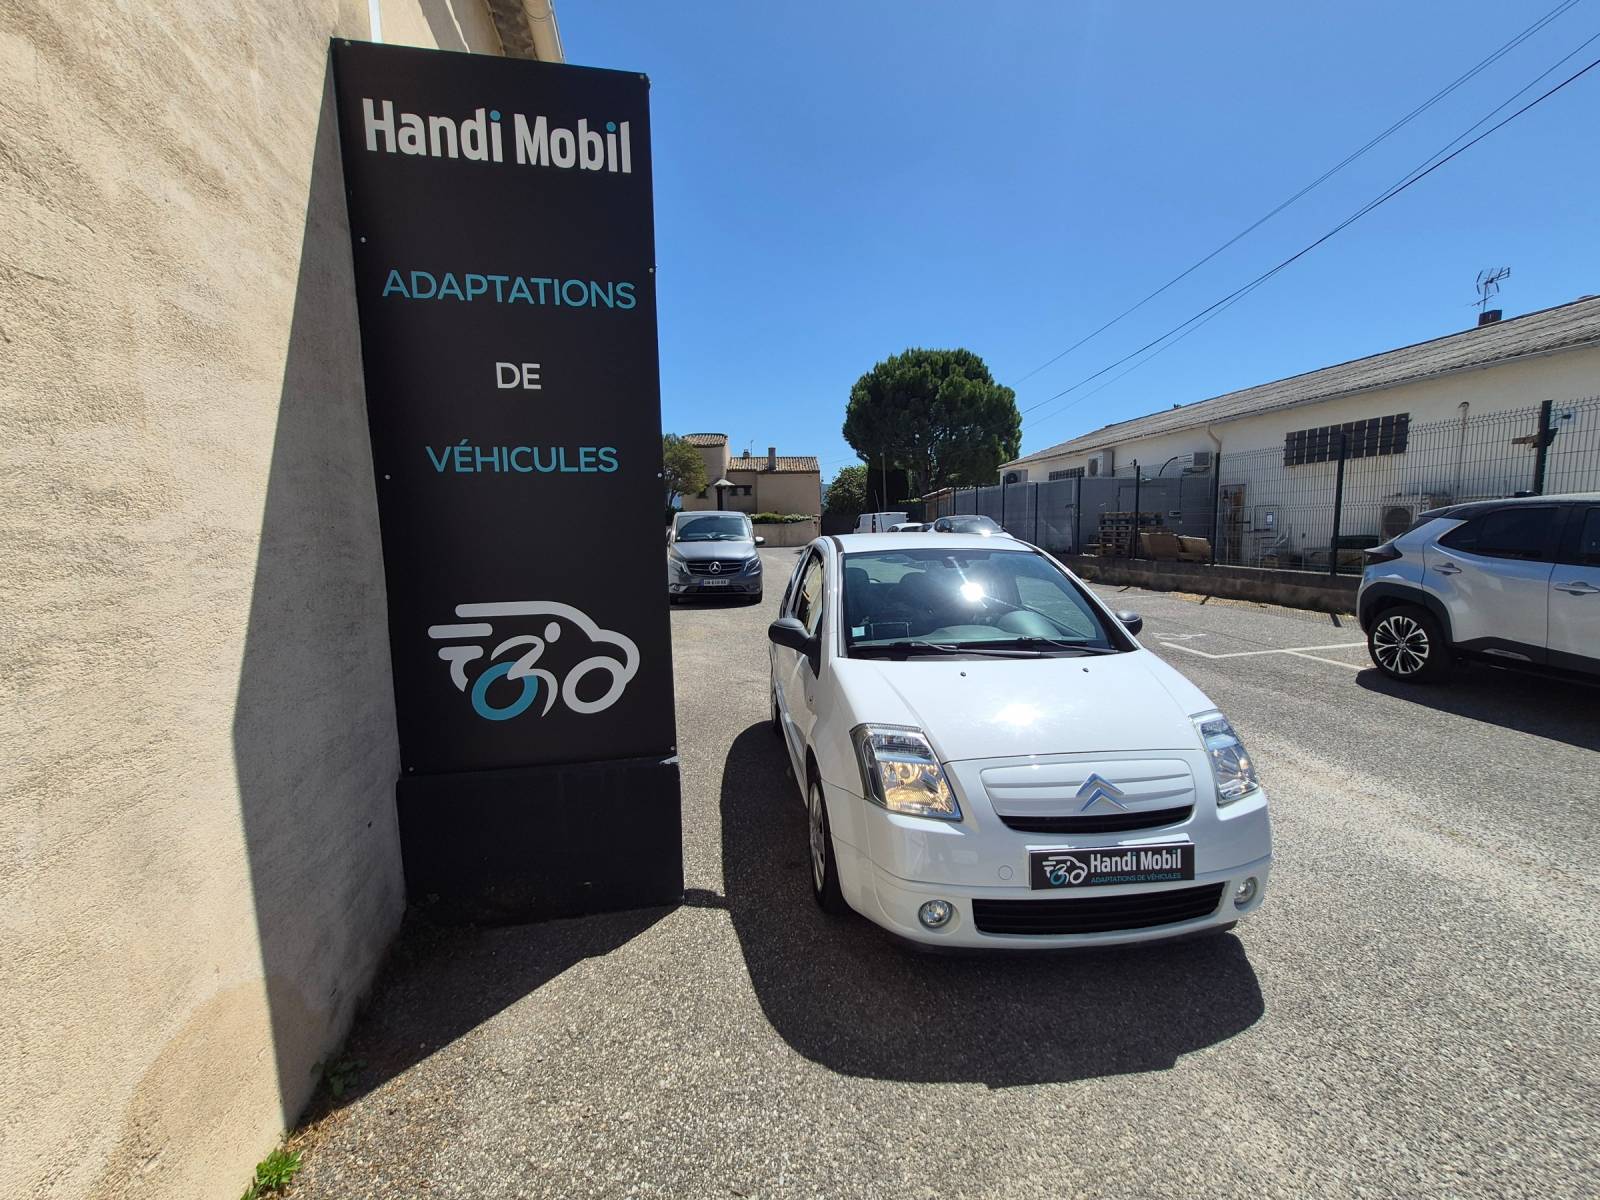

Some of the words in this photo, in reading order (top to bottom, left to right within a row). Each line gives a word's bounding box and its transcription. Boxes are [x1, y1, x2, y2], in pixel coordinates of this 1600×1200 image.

[362, 98, 503, 163] Handi
[513, 113, 632, 173] Mobil
[382, 269, 637, 309] ADAPTATIONS
[496, 361, 542, 390] DE
[425, 438, 619, 473] VÉHICULES
[1090, 851, 1137, 873] Handi
[1140, 849, 1182, 870] Mobil
